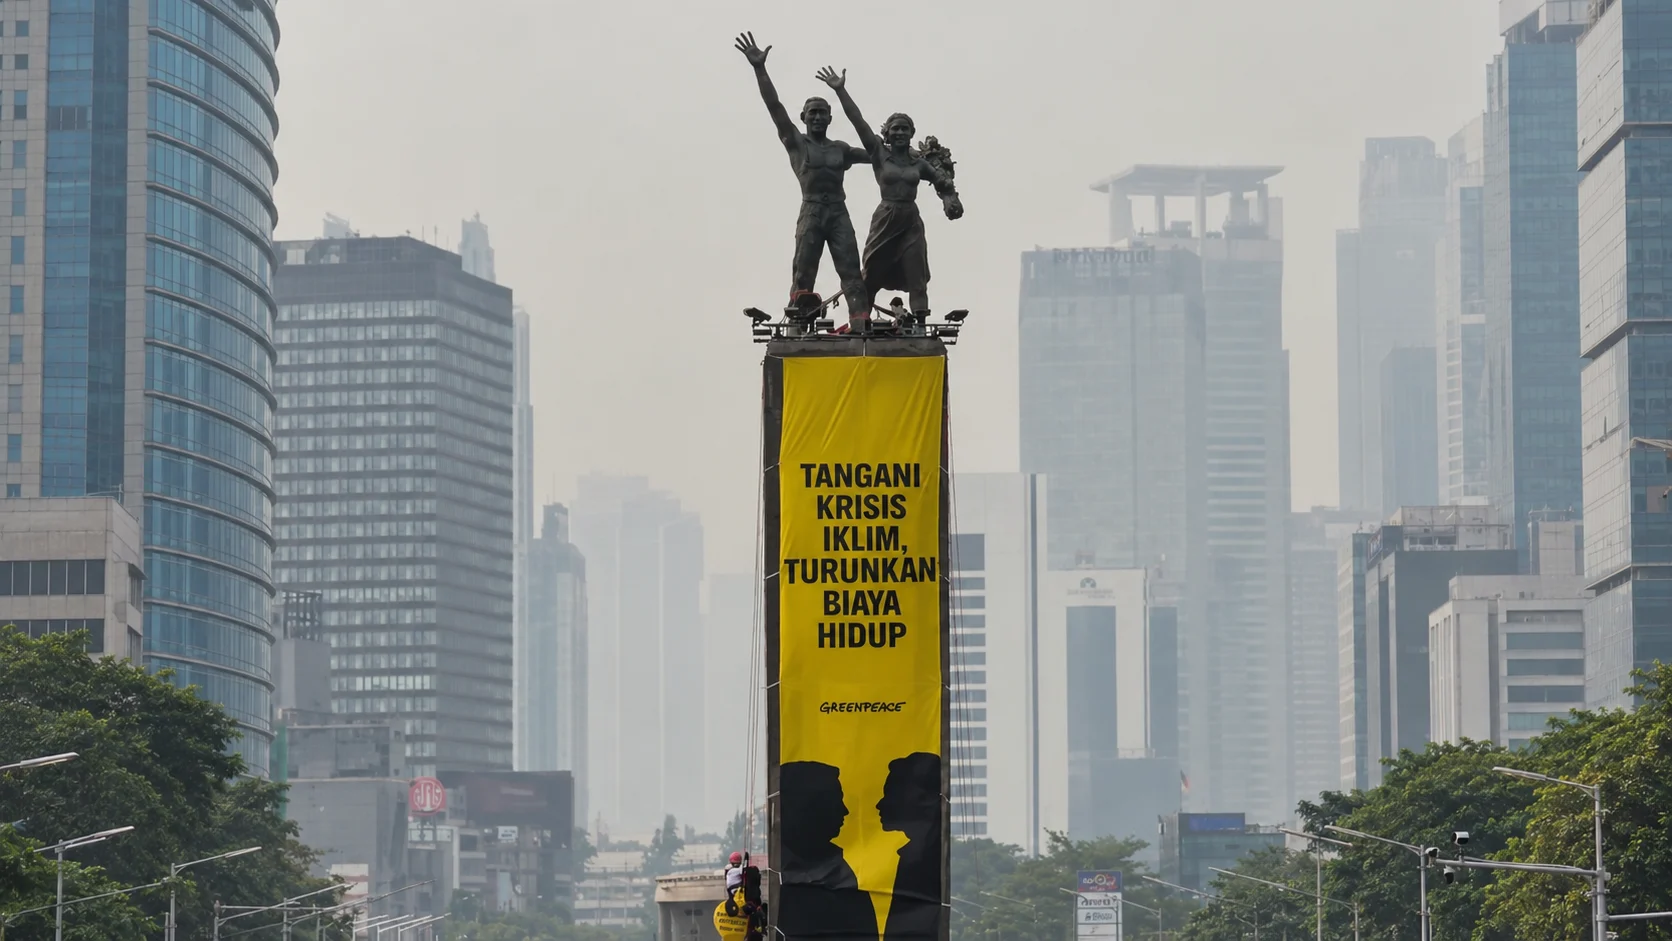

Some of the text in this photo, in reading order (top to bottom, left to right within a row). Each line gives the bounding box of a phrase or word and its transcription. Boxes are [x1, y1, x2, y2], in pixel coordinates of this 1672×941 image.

[800, 462, 920, 488] TANGANI
[816, 493, 907, 519] KRISIS
[823, 525, 908, 555] IKLIM,
[784, 557, 936, 584] TURUNKAN
[823, 590, 901, 616] BIAYA
[818, 622, 907, 648] HIDUP
[819, 701, 906, 714] GREENPEACE
